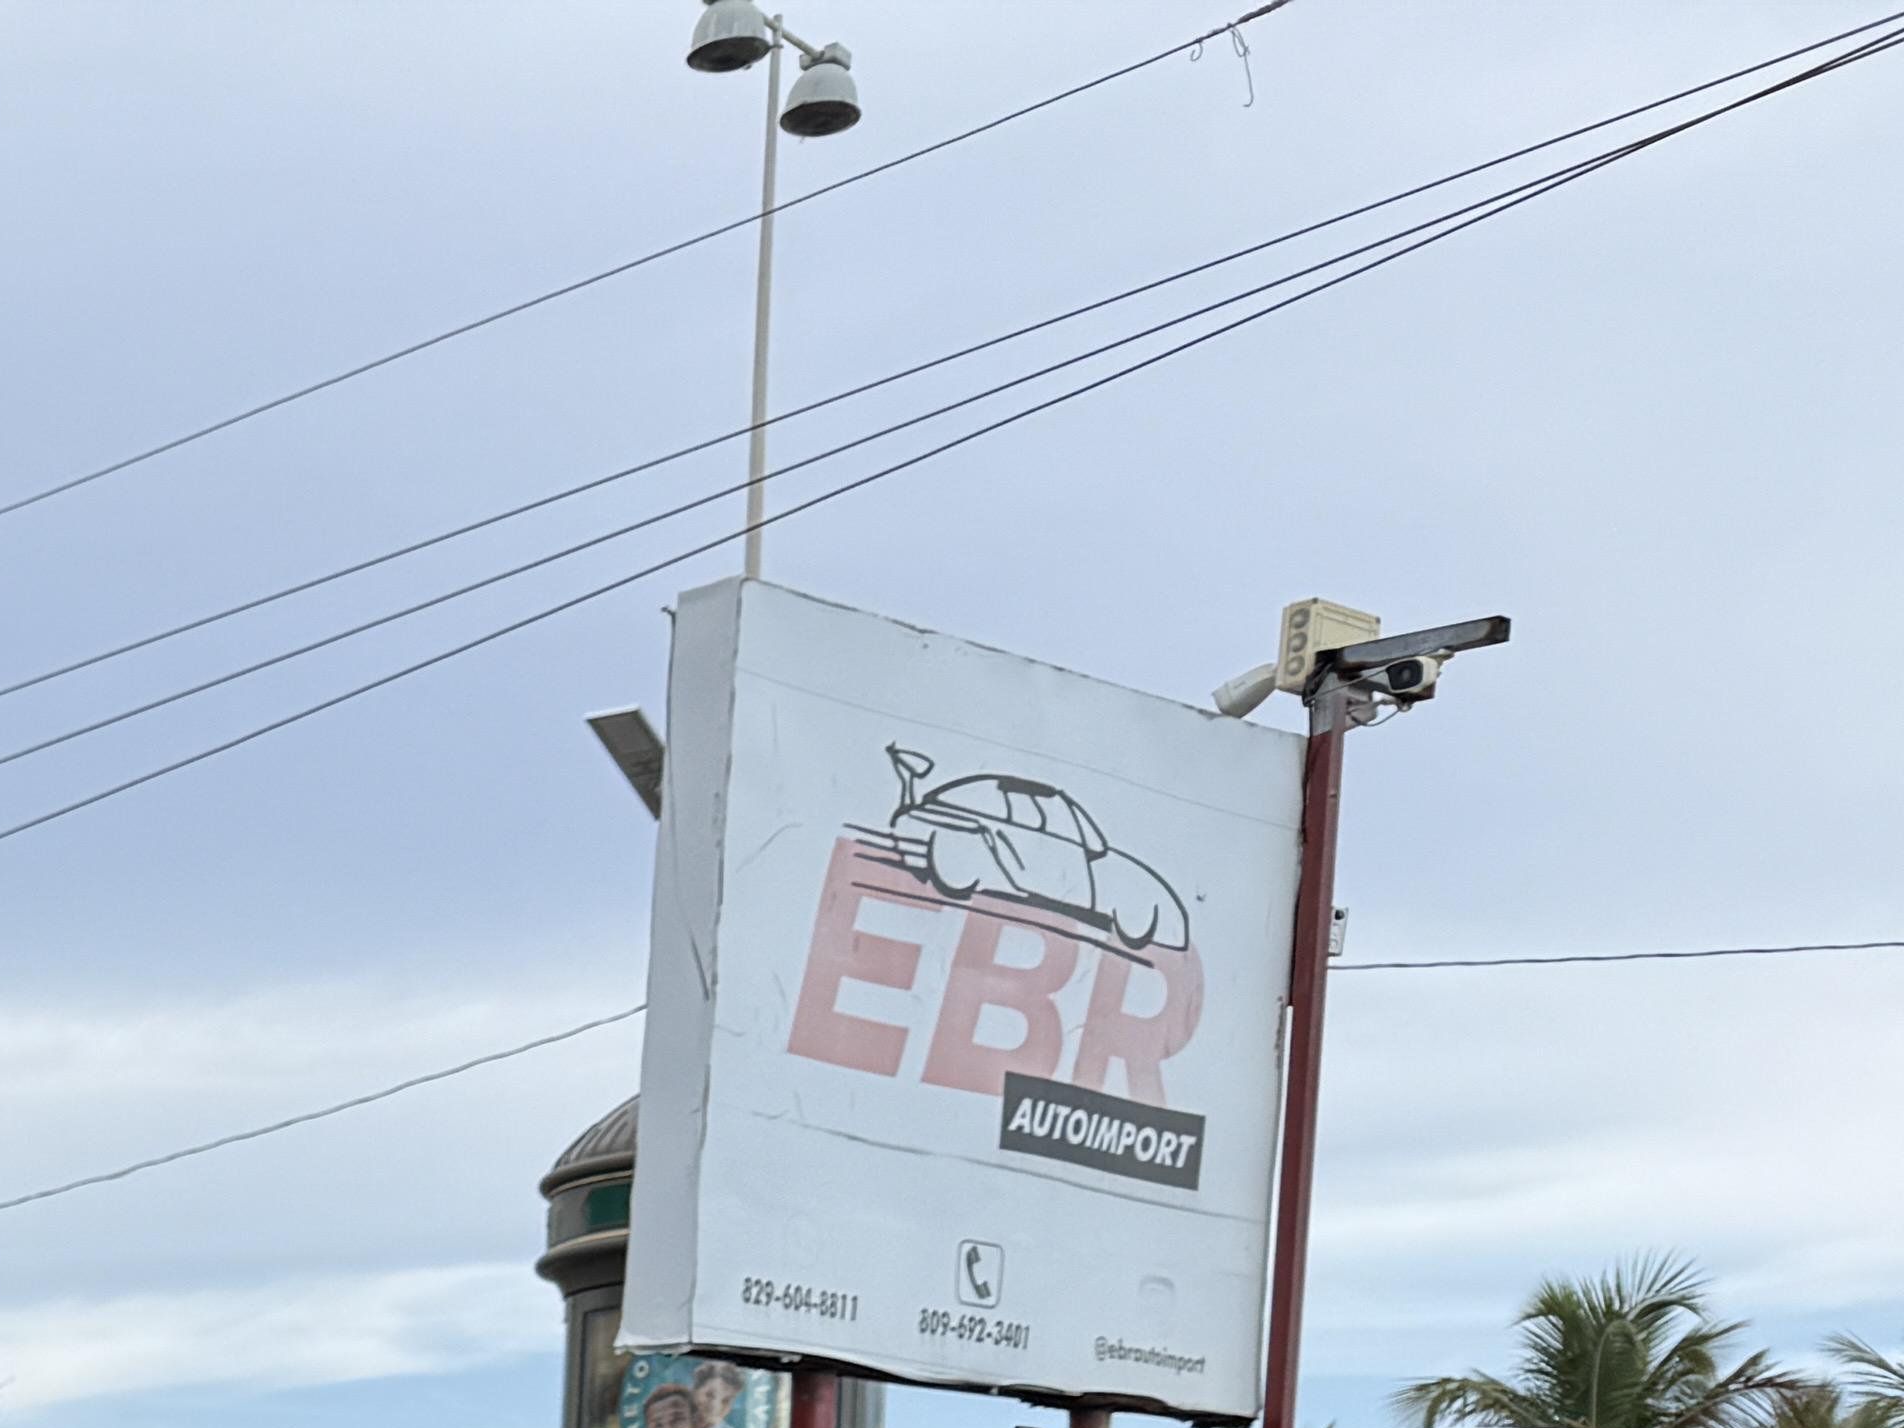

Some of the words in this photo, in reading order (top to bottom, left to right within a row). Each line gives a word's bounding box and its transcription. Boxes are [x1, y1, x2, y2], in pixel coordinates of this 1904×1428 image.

[786, 836, 1205, 1106] EBR
[1008, 1097, 1197, 1170] AUTOIMPORT
[741, 1276, 859, 1321] 829-604-8811
